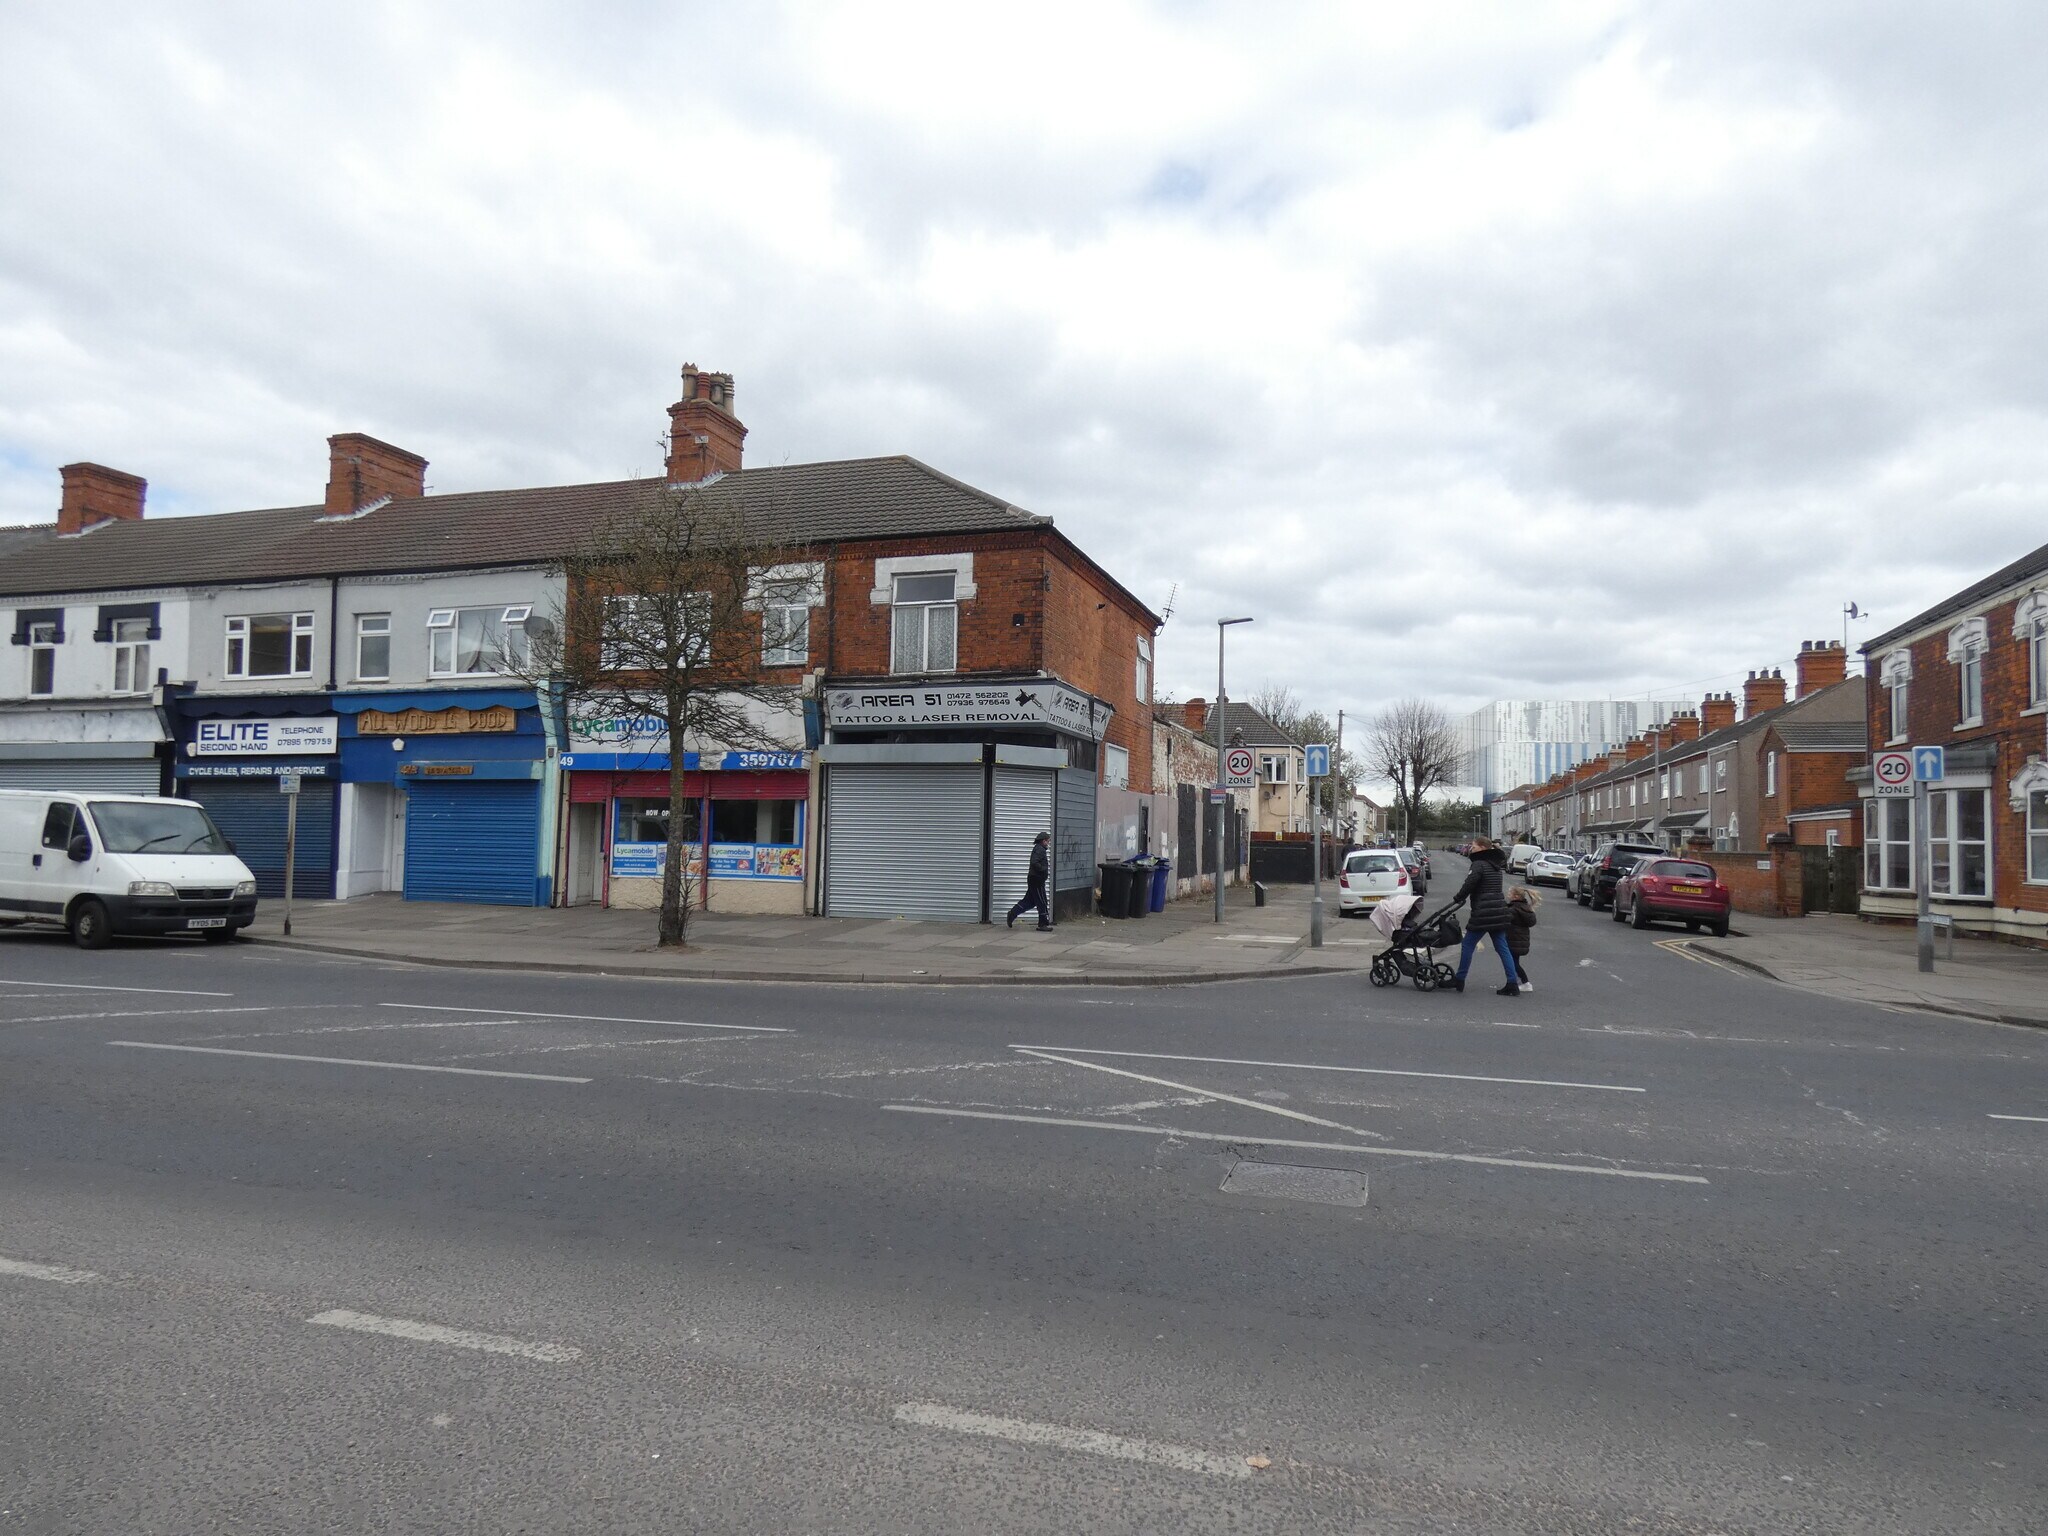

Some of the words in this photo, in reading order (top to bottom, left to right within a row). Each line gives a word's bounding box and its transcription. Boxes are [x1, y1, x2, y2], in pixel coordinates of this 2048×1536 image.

[861, 694, 914, 707] AREA
[924, 694, 942, 705] 51
[1063, 697, 1079, 713] AREA
[361, 710, 387, 730] ALL
[395, 710, 437, 731] WOOD
[442, 711, 457, 729] IS
[836, 715, 893, 723] TATTOO
[897, 714, 906, 722] &
[912, 714, 960, 722] LASER
[966, 713, 1041, 721] REMOVAL
[570, 714, 669, 736] Lycamobil
[1050, 713, 1067, 726] TATTOO
[1086, 726, 1103, 738] REOVAL
[201, 723, 269, 741] ELITE
[241, 743, 268, 751] HAND
[560, 757, 574, 766] 49
[1231, 757, 1250, 768] 20
[188, 767, 212, 775] CYCLE
[213, 767, 239, 777] SALES,
[241, 767, 272, 775] REPAIRS
[274, 767, 291, 775] AND
[1882, 763, 1906, 775] 20
[1878, 786, 1910, 794] ZONE
[616, 847, 654, 855] Lycamobile
[711, 847, 751, 856] Lycamobile
